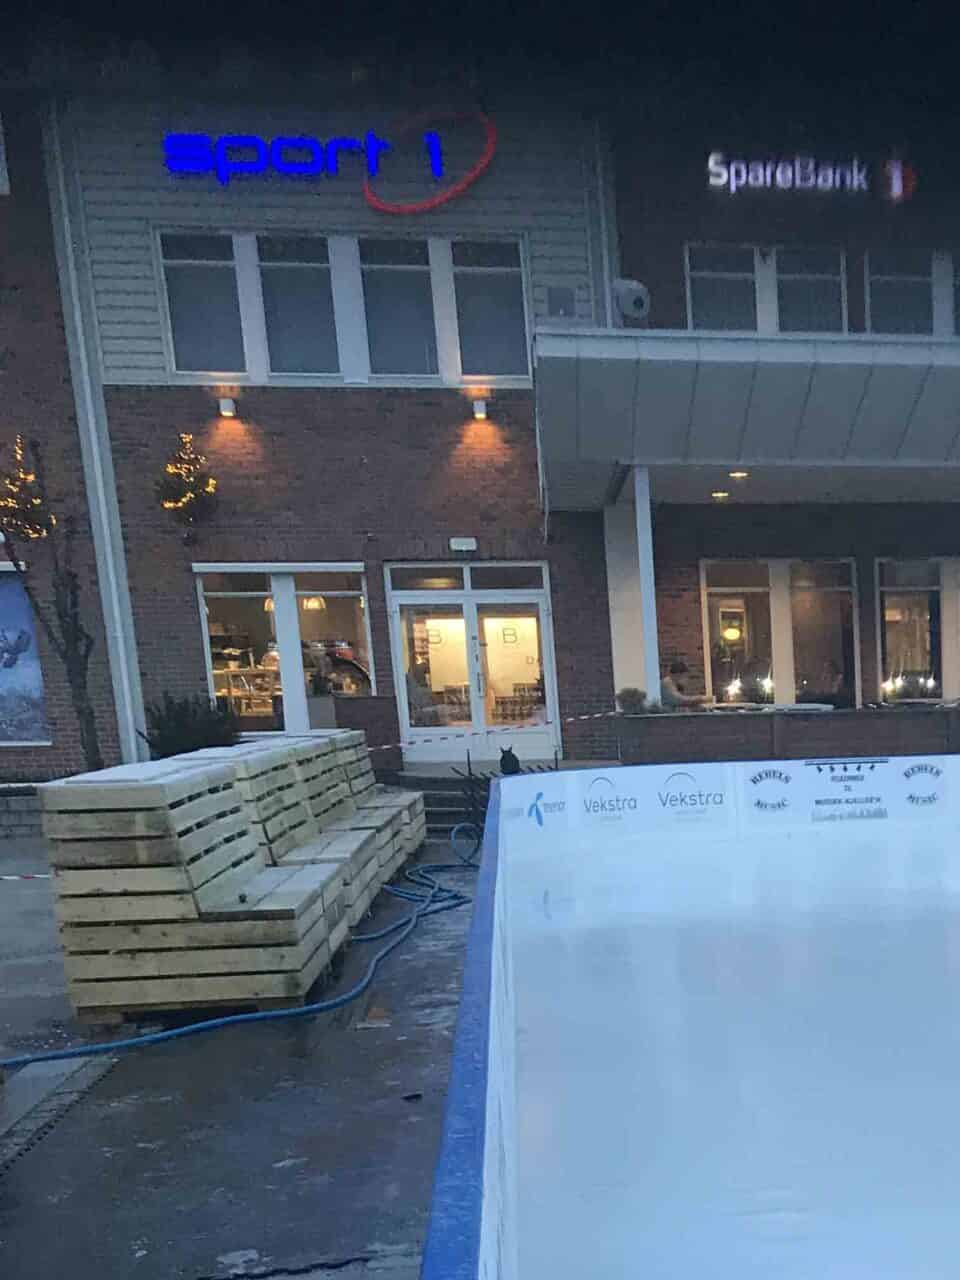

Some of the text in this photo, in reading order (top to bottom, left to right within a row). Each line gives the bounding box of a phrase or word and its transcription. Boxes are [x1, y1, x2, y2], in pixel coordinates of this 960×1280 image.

[163, 130, 445, 186] sport 1
[707, 153, 869, 193] SpareBank
[584, 796, 638, 814] Vekstra
[658, 791, 726, 808] Vekstra
